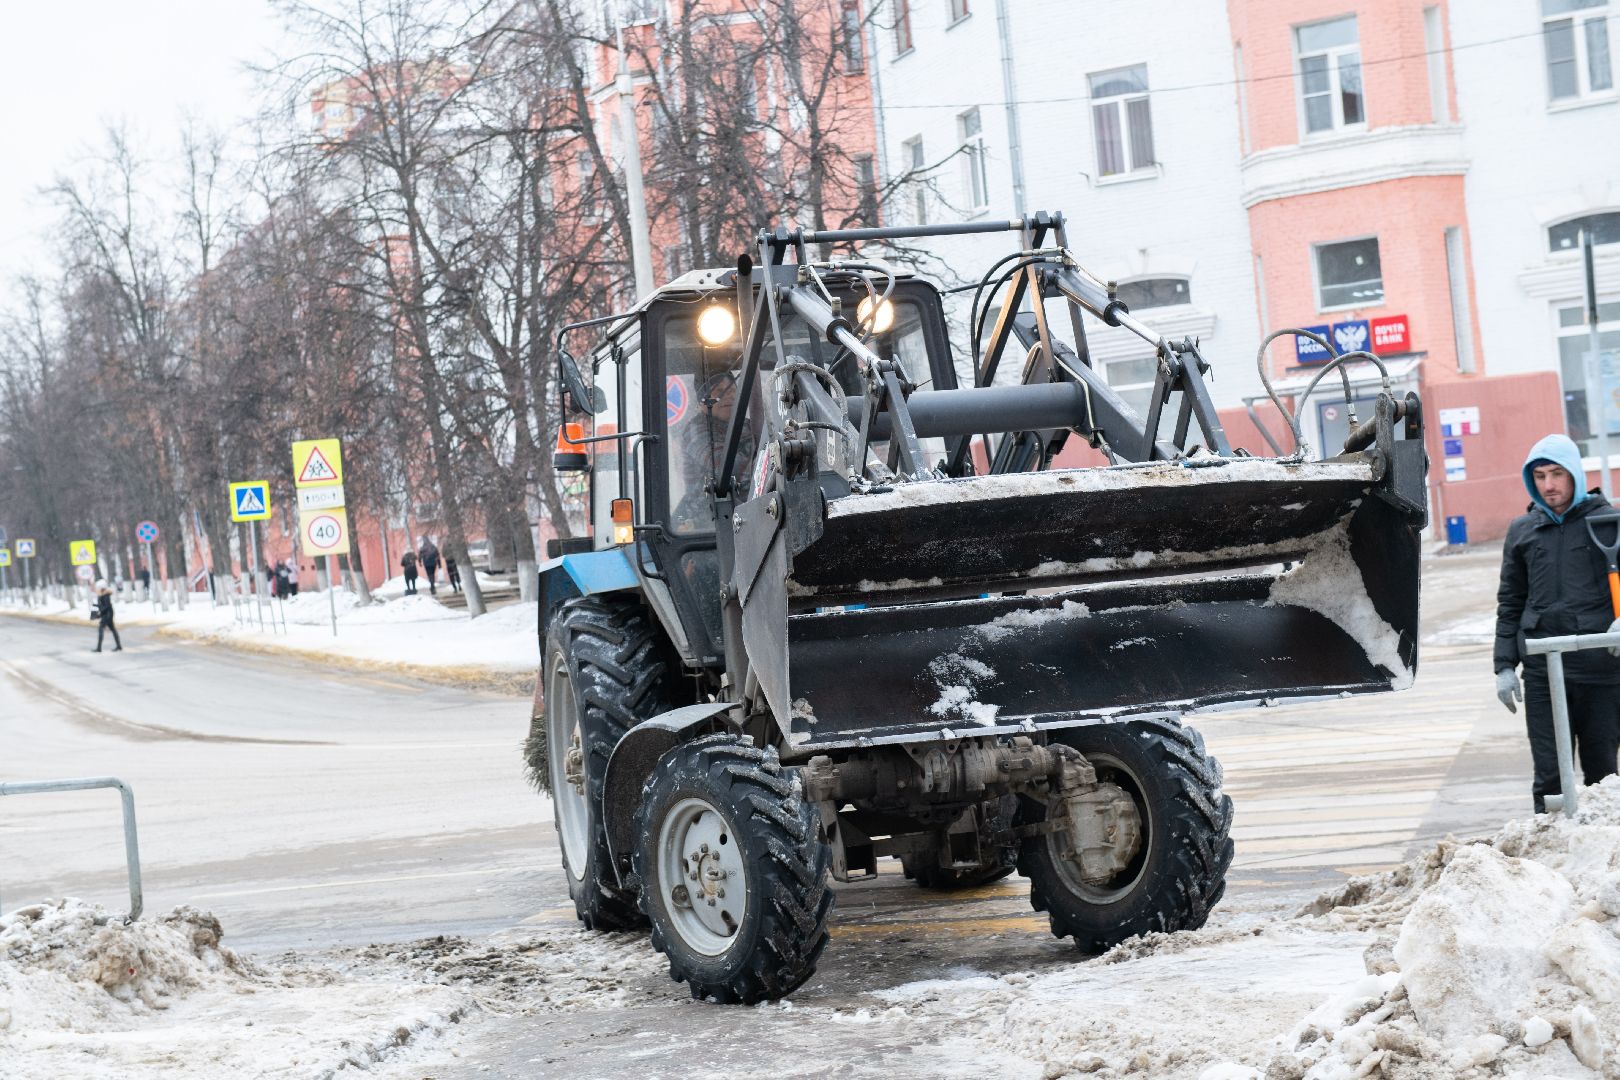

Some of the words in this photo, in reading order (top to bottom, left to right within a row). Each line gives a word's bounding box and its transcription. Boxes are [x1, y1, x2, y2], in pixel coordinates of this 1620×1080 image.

[1375, 323, 1405, 335] ПОЧТА
[1376, 334, 1403, 345] БАНК
[316, 525, 335, 539] 40
